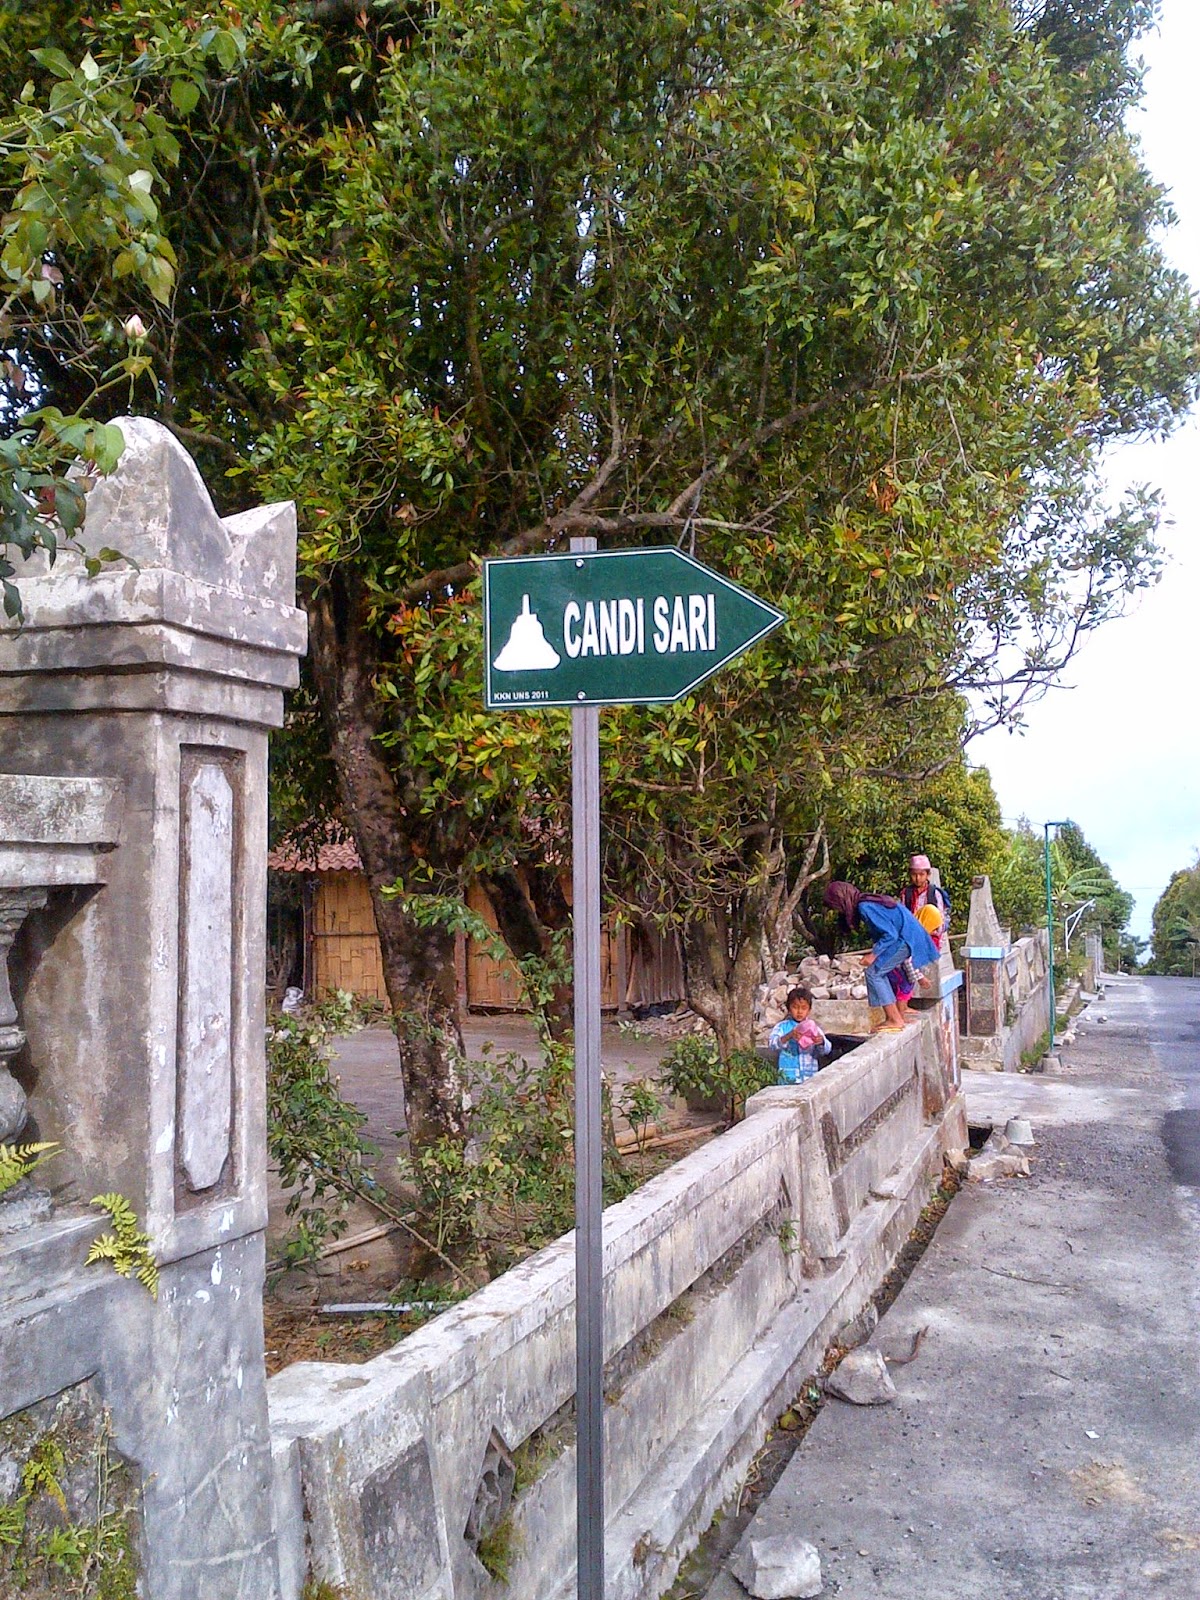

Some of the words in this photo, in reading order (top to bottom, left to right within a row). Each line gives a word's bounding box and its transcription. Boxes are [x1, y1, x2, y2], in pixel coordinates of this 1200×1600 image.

[563, 597, 645, 659] CANDI
[653, 593, 716, 655] SARI
[493, 692, 511, 701] KKN
[512, 691, 530, 700] UNS
[531, 690, 549, 699] 2011
